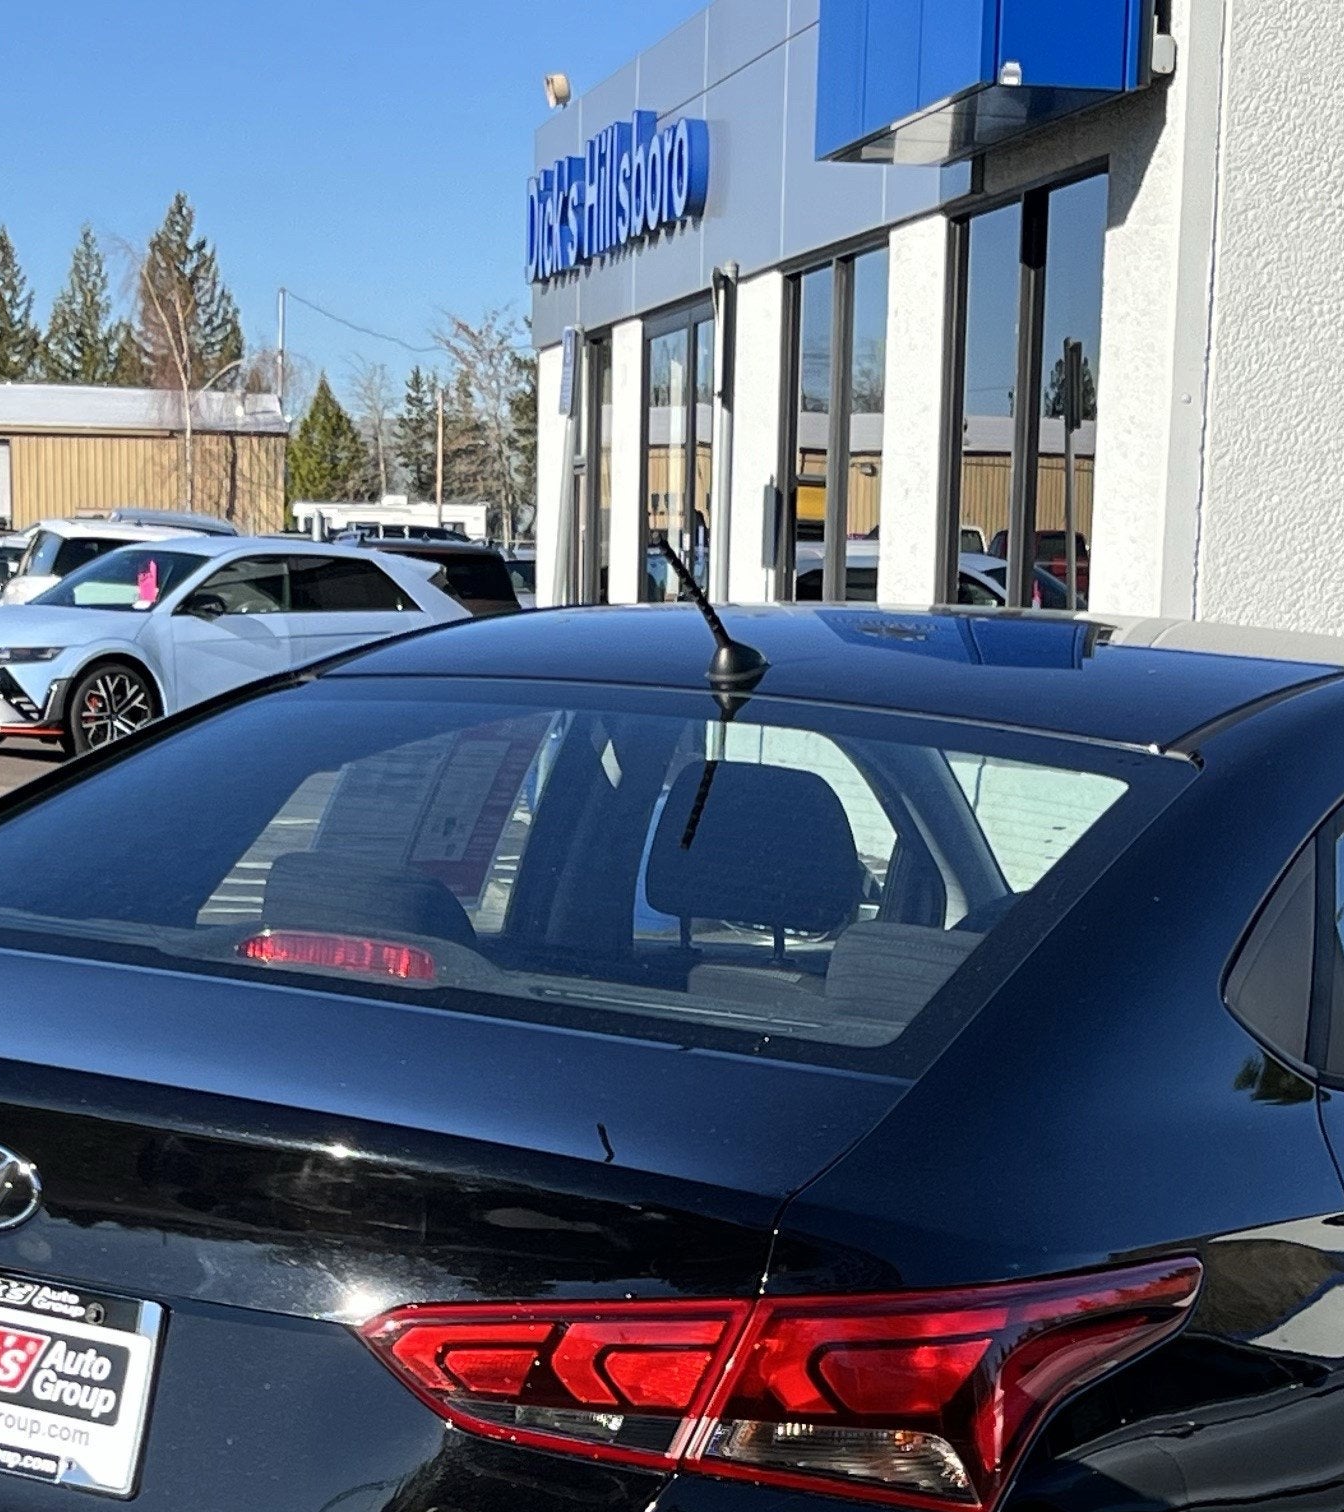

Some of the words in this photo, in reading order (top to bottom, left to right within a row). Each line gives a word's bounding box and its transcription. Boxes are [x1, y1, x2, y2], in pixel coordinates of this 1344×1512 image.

[526, 156, 581, 284] Dick's
[584, 110, 702, 259] Hillsboro
[41, 1340, 112, 1381] Auto
[31, 1367, 117, 1418] Group
